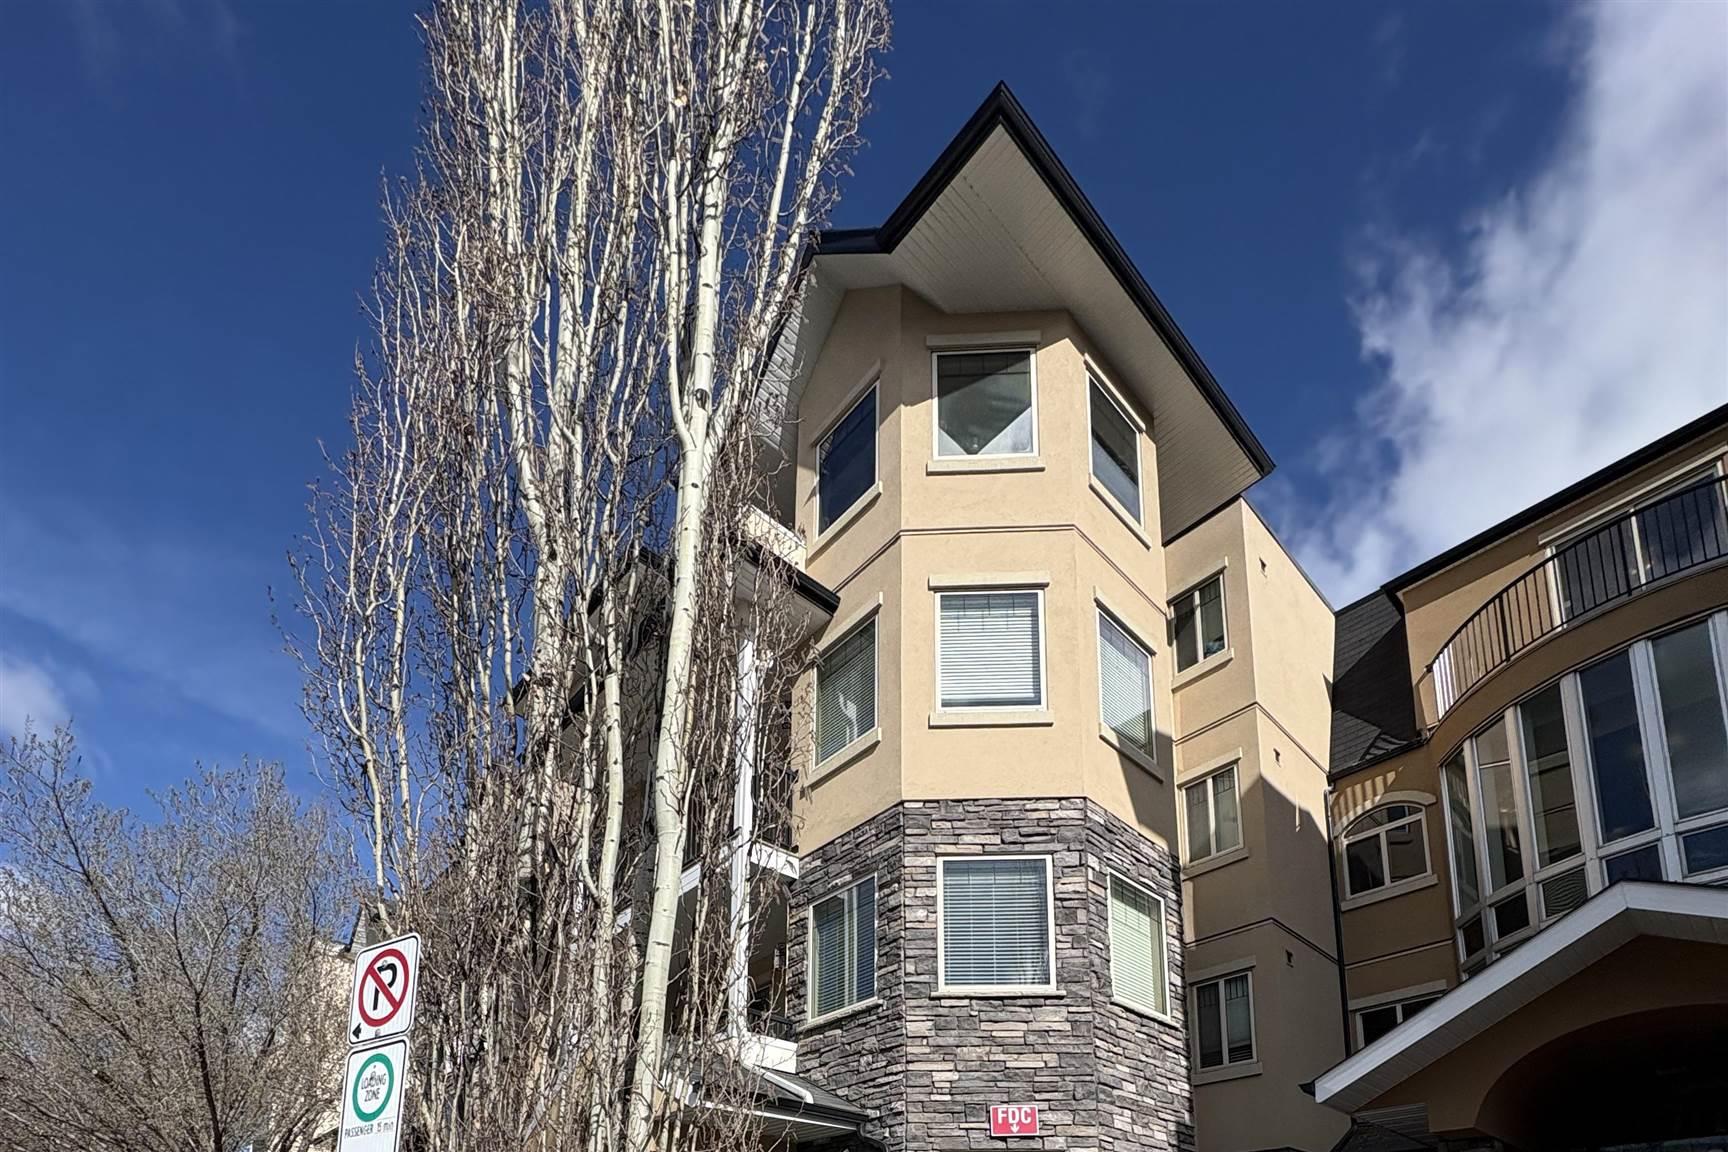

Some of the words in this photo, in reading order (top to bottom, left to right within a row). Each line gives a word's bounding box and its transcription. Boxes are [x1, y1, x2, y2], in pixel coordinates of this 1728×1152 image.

[372, 962, 398, 1011] P
[361, 1072, 387, 1090] LOADING
[364, 1087, 381, 1103] ZONE
[997, 1107, 1032, 1124] FDC
[344, 1123, 374, 1139] PASSENGER
